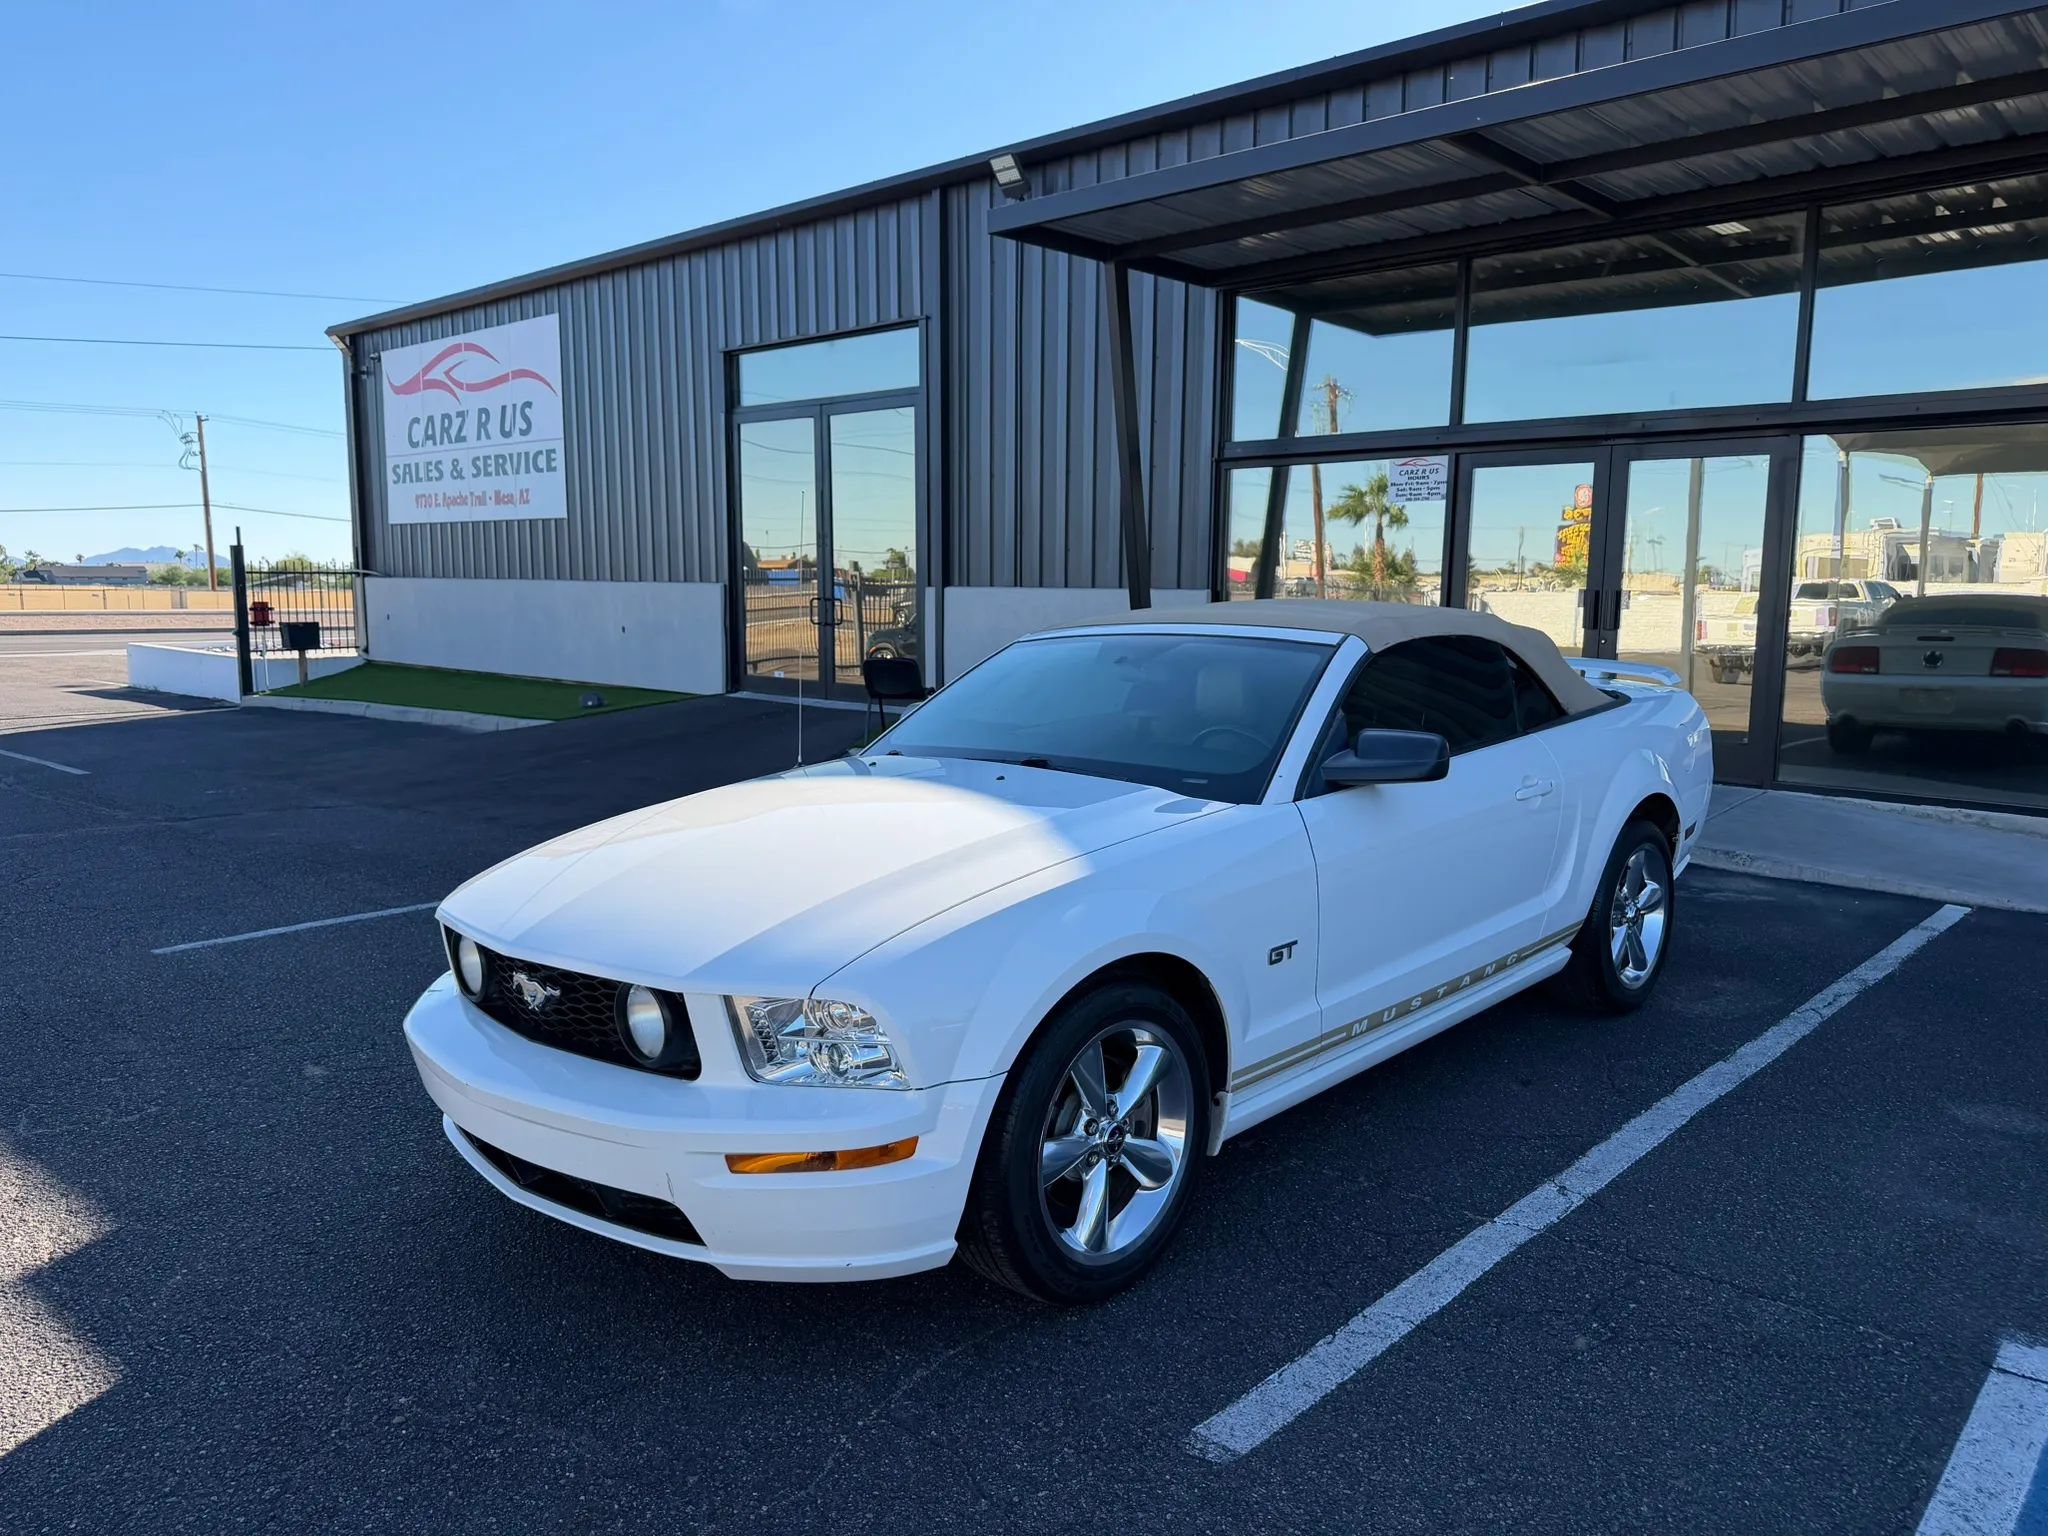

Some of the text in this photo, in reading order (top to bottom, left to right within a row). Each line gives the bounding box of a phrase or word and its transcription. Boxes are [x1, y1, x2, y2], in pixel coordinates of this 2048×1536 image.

[407, 400, 533, 449] CARZ R US
[391, 448, 558, 485] SALES & SERVICE
[442, 490, 468, 510] Apache
[469, 490, 487, 507] Trail
[519, 487, 530, 505] AZ
[1269, 940, 1298, 965] GT
[1351, 952, 1518, 1038] MUSTANG
